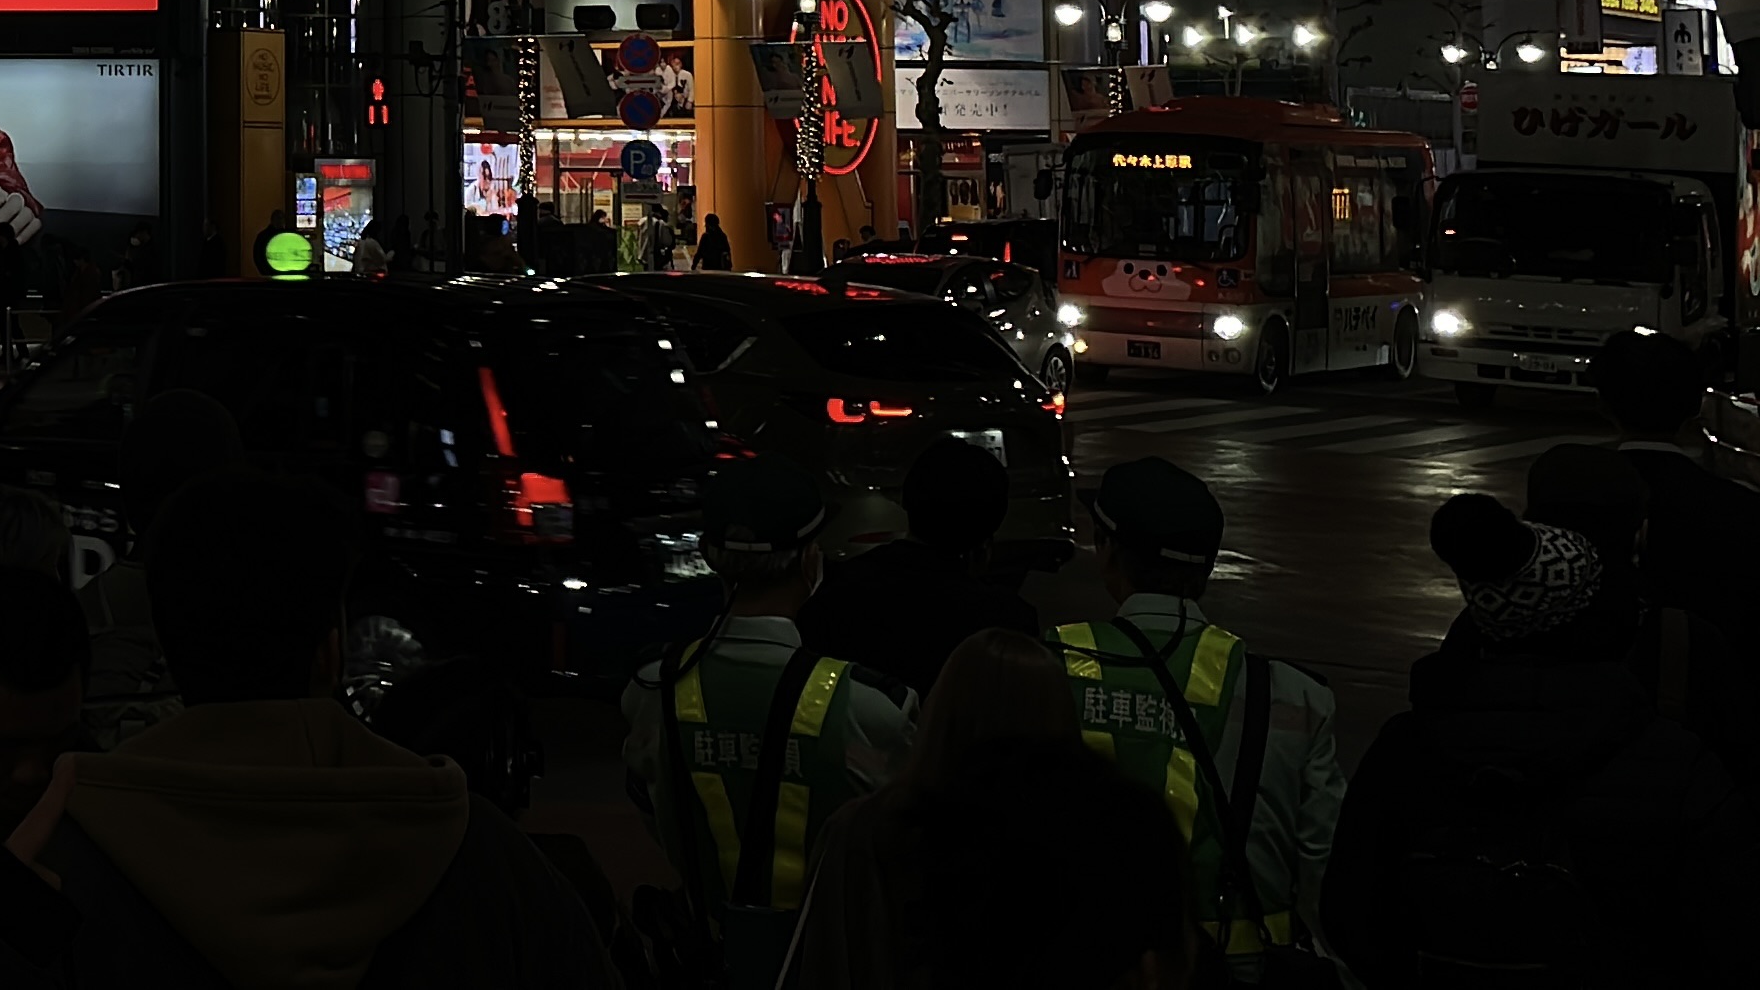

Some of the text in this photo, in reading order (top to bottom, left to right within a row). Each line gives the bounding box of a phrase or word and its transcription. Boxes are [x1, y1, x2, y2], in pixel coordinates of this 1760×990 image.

[821, 0, 849, 31] NO
[97, 64, 154, 77] TIRTIR
[1512, 106, 1698, 141] ひげガール
[630, 150, 646, 175] P
[1083, 686, 1198, 743] 駐車監視
[693, 730, 806, 779] 駐車監員
